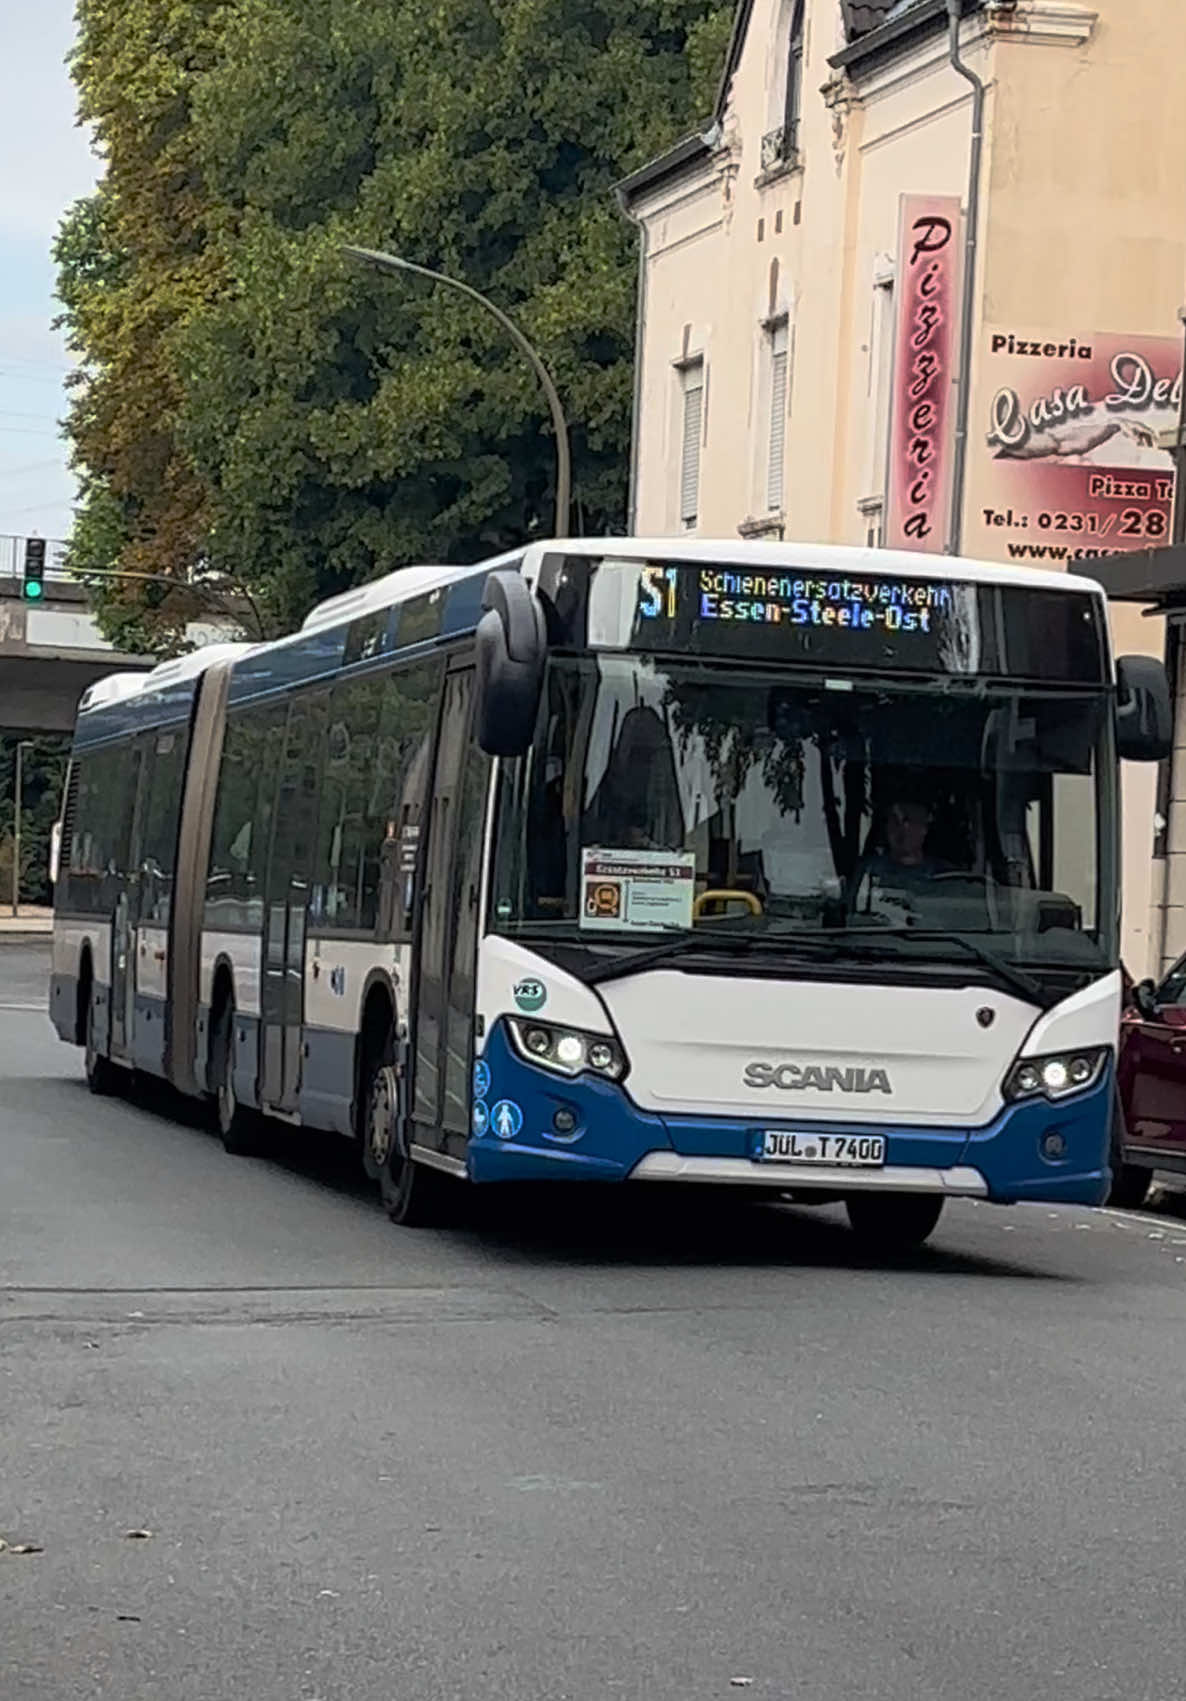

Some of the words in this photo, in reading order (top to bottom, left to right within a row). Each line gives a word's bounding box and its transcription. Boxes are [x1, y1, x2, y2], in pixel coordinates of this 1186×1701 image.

[991, 335, 1092, 359] Pizzeria
[904, 216, 951, 539] Pizzeria
[987, 386, 1088, 445] Casa
[1092, 477, 1148, 497] Pizza
[983, 510, 1028, 528] Tel.:
[640, 567, 677, 618] S1
[700, 570, 949, 606] Schienenersatzverkehr
[701, 593, 931, 632] Essen-Steele-Ost
[743, 1063, 892, 1094] SCANIA
[818, 1136, 830, 1158] T
[835, 1138, 882, 1161] 7400
